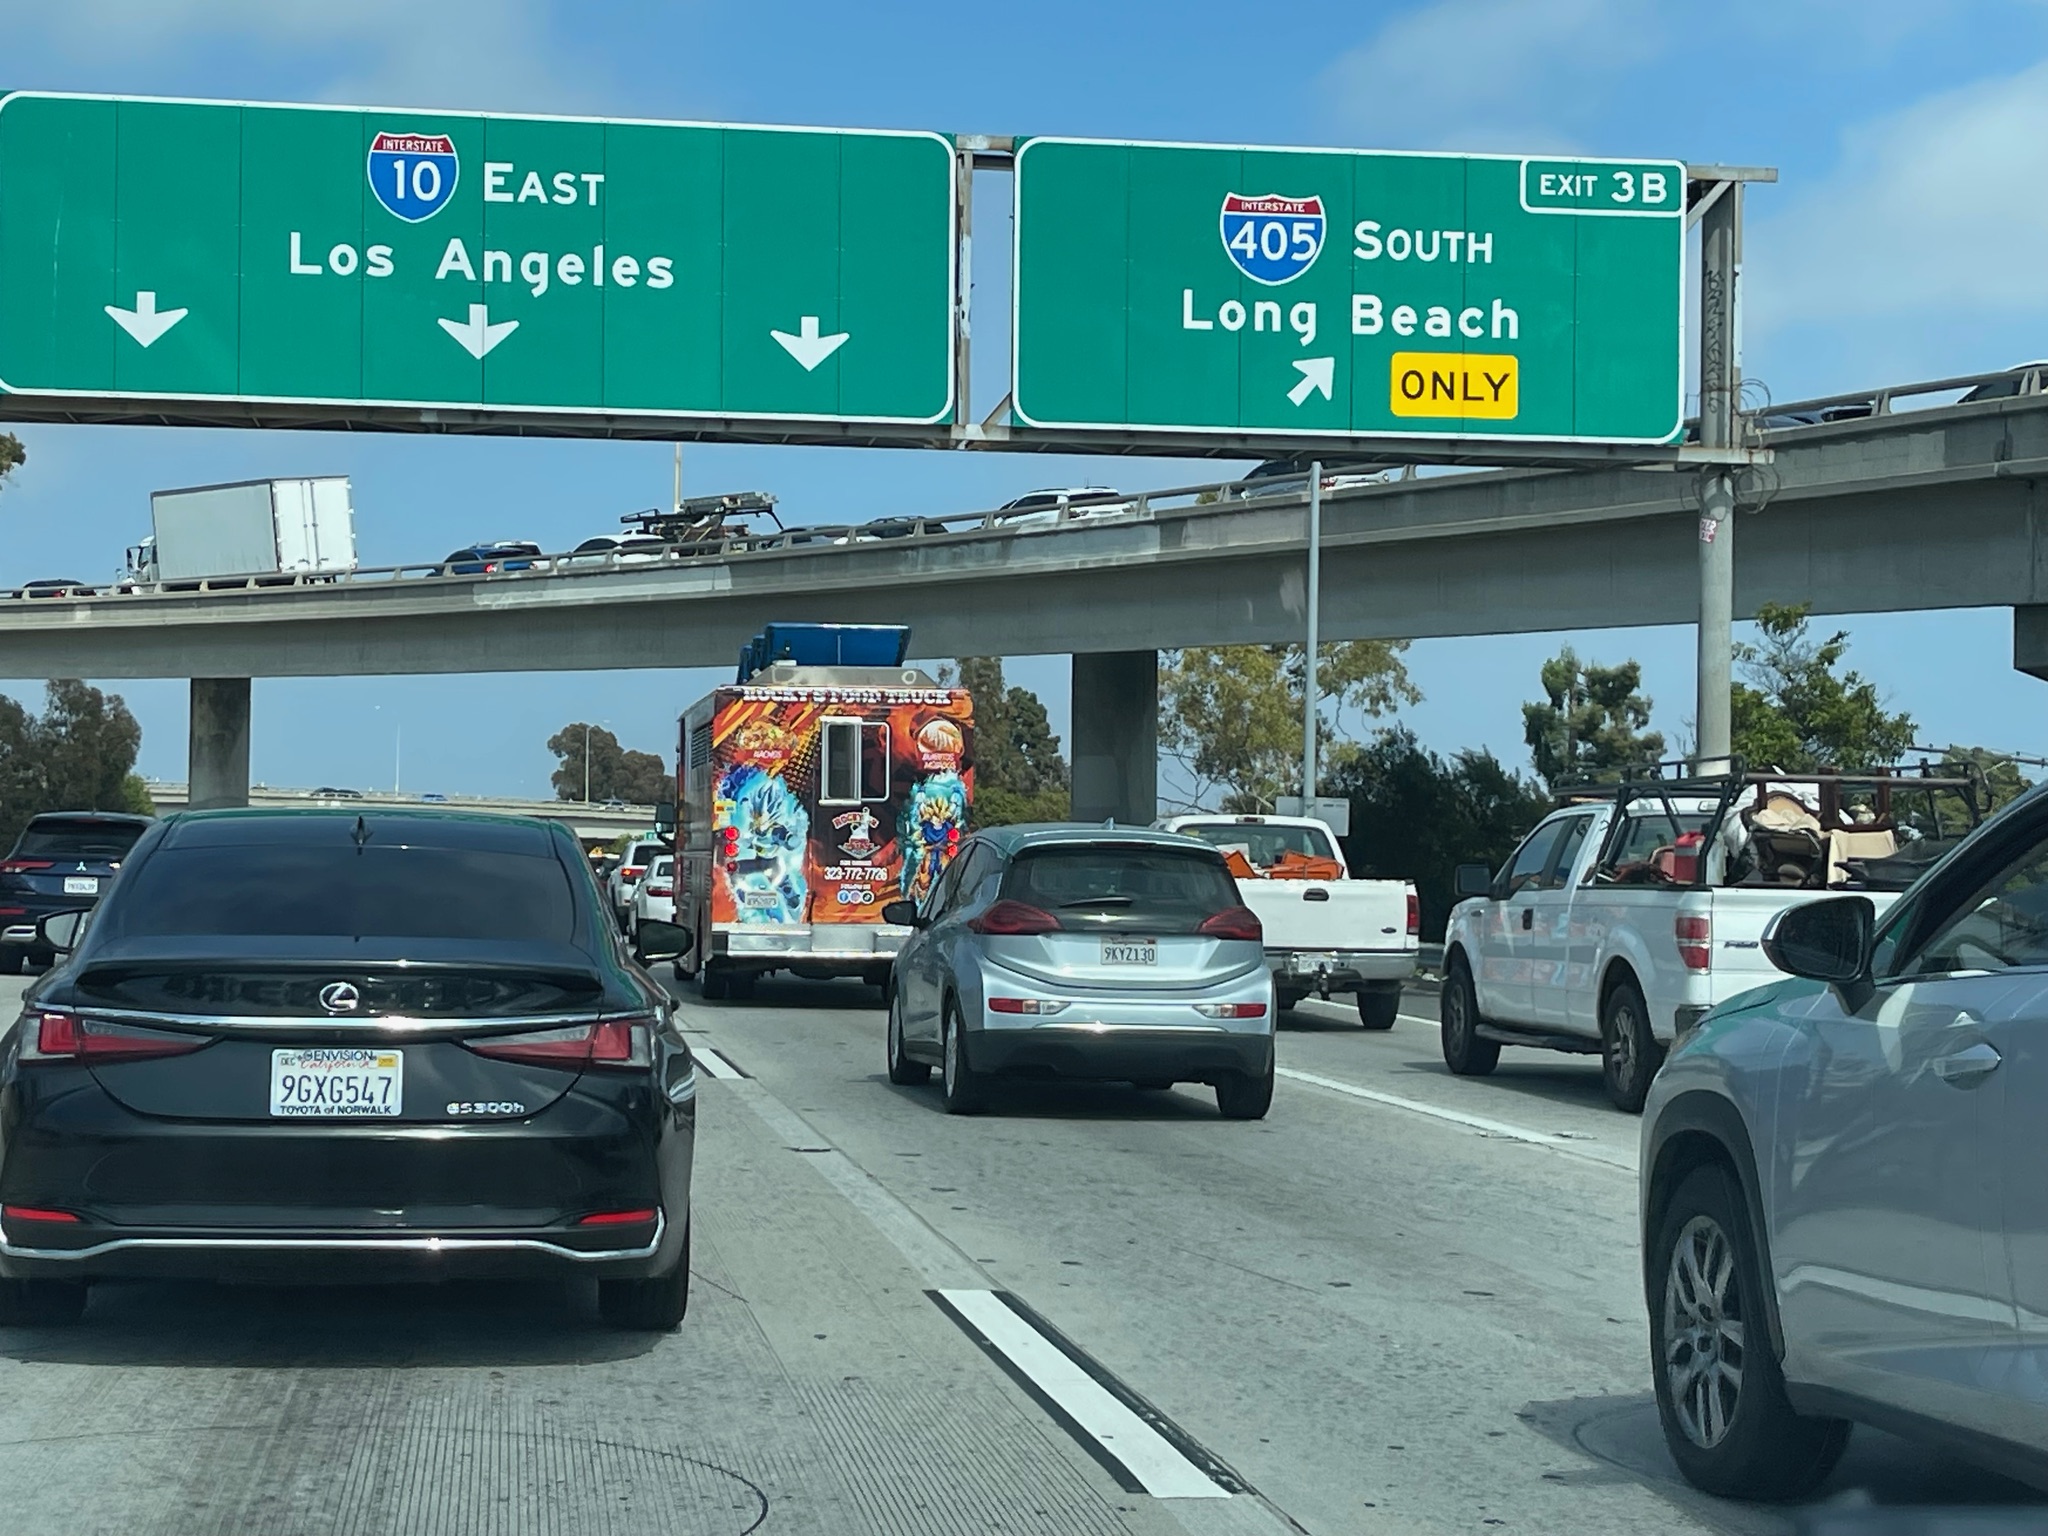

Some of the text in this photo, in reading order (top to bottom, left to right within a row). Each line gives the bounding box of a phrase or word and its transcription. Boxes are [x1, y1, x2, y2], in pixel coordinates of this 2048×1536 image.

[382, 139, 444, 153] INTERSTATE
[393, 159, 441, 201] 10
[484, 162, 605, 206] EAST
[1540, 171, 1667, 203] EXIT 3B
[1241, 201, 1305, 213] INTERSTATE
[1229, 220, 1317, 261] 405
[1353, 220, 1493, 263] SOUTH
[290, 232, 674, 297] Los Angeles
[1183, 288, 1522, 346] Long Beach
[1401, 370, 1512, 402] ONLY
[1104, 947, 1155, 961] 9KYZ130
[281, 1074, 393, 1104] 9GXG547
[280, 1105, 392, 1115] TOYOTA of NORWALK
